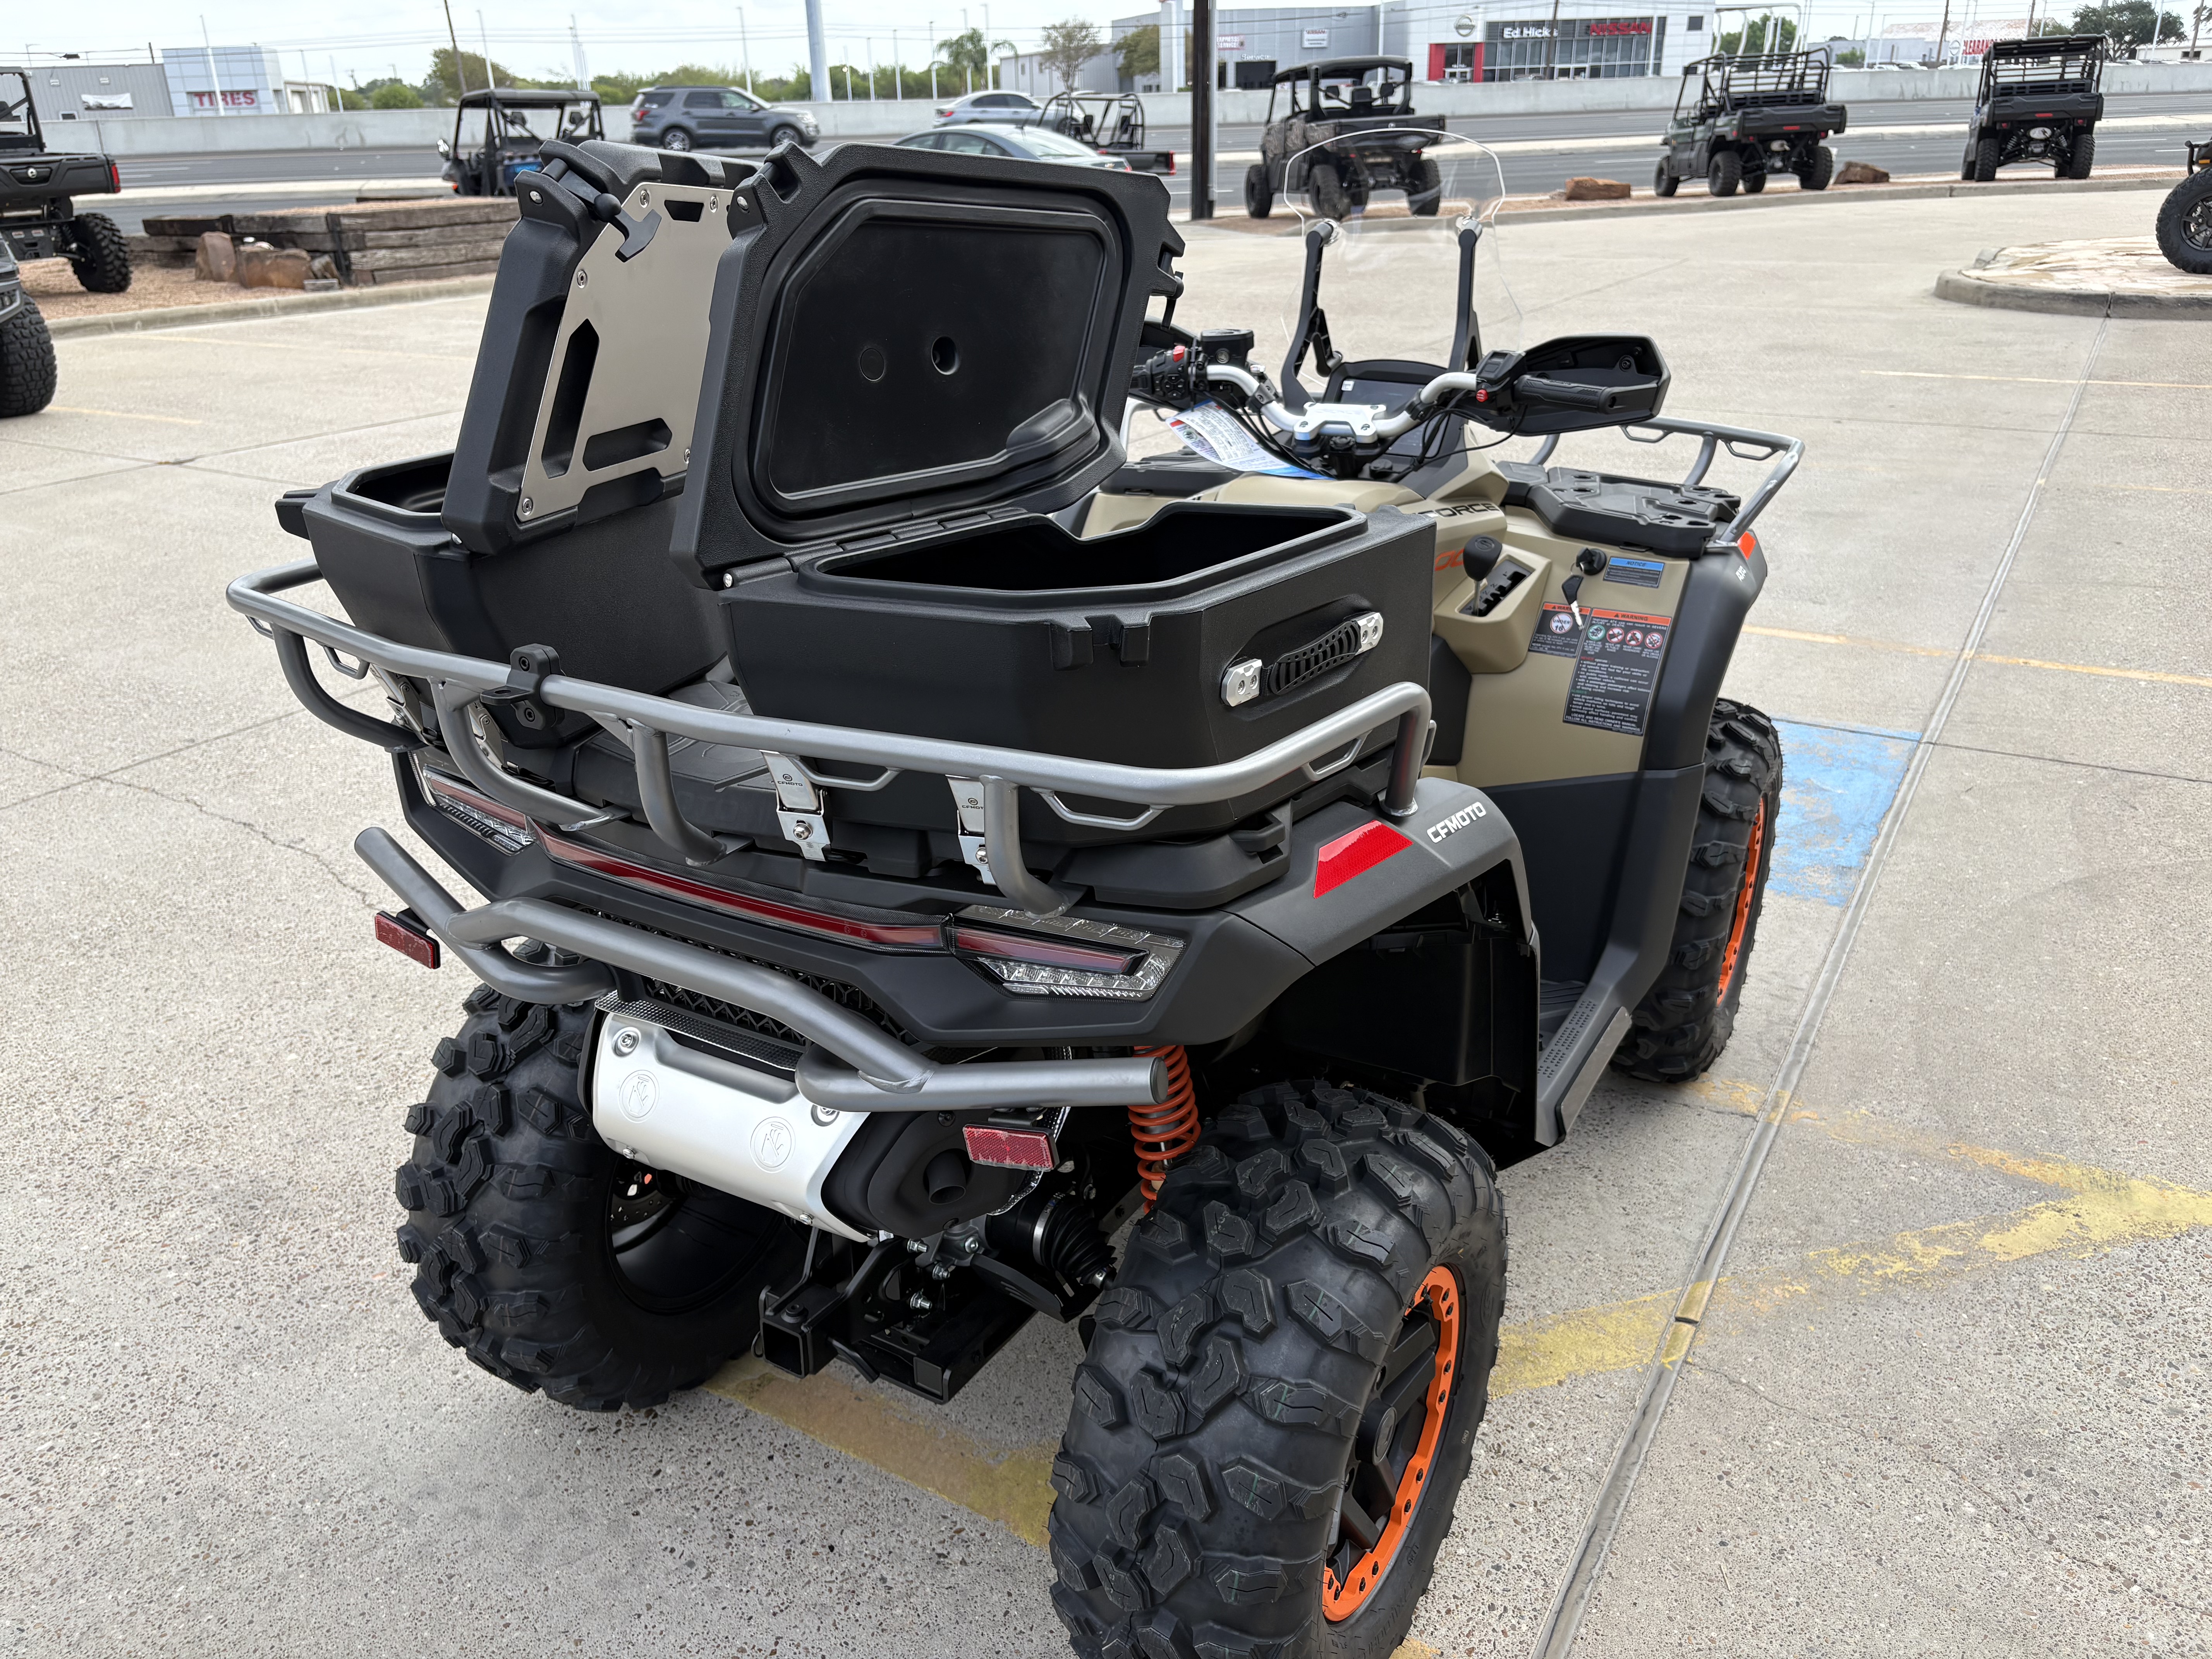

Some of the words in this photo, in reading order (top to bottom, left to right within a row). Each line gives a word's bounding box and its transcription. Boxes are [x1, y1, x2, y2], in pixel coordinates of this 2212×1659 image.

[1590, 22, 1651, 36] NISSAN
[194, 91, 255, 107] TIRES
[1427, 802, 1487, 843] CFMOTO
